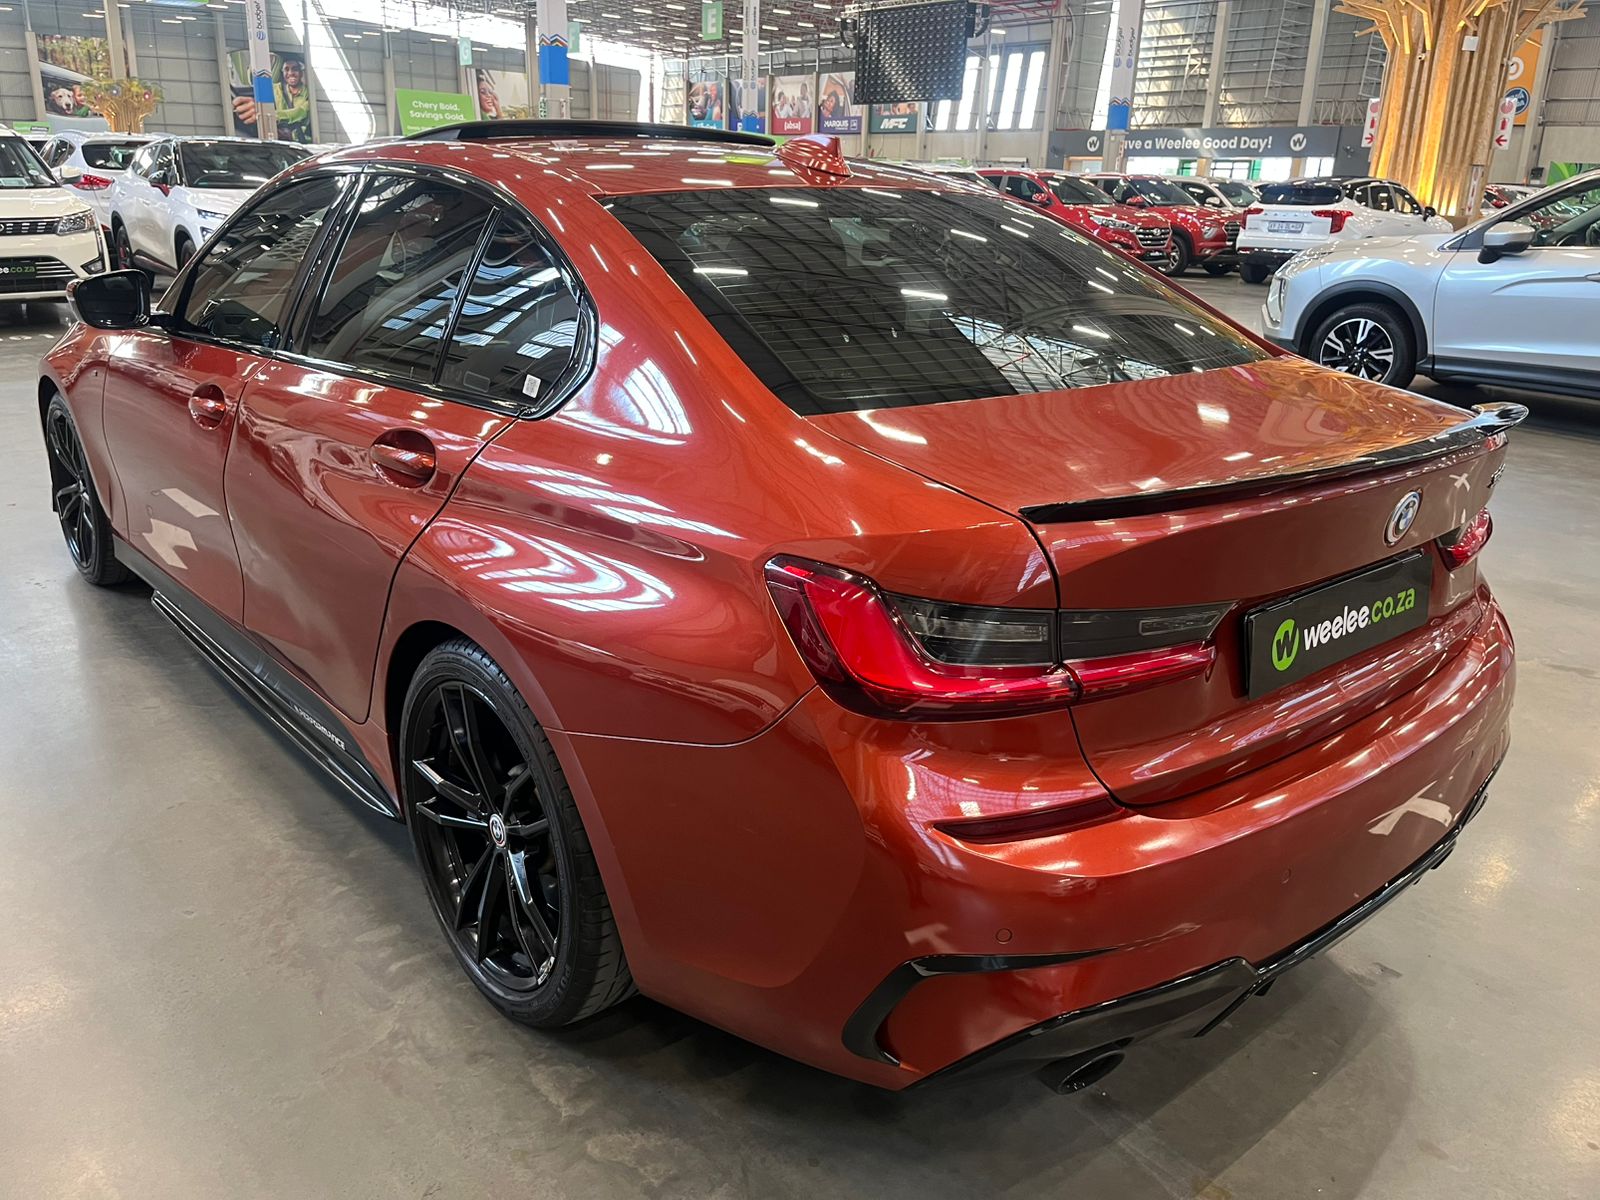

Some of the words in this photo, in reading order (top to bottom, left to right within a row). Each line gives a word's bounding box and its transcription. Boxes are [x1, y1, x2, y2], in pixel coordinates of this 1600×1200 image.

[707, 8, 716, 33] E
[411, 100, 438, 111] Chery
[409, 110, 443, 121] Savings
[880, 118, 908, 129] MFC
[1124, 139, 1142, 150] ve
[1144, 140, 1153, 150] a
[1155, 137, 1201, 150] Weelee
[1203, 136, 1238, 149] Good
[1240, 135, 1273, 153] Day!
[1304, 588, 1416, 651] weelee.co.za
